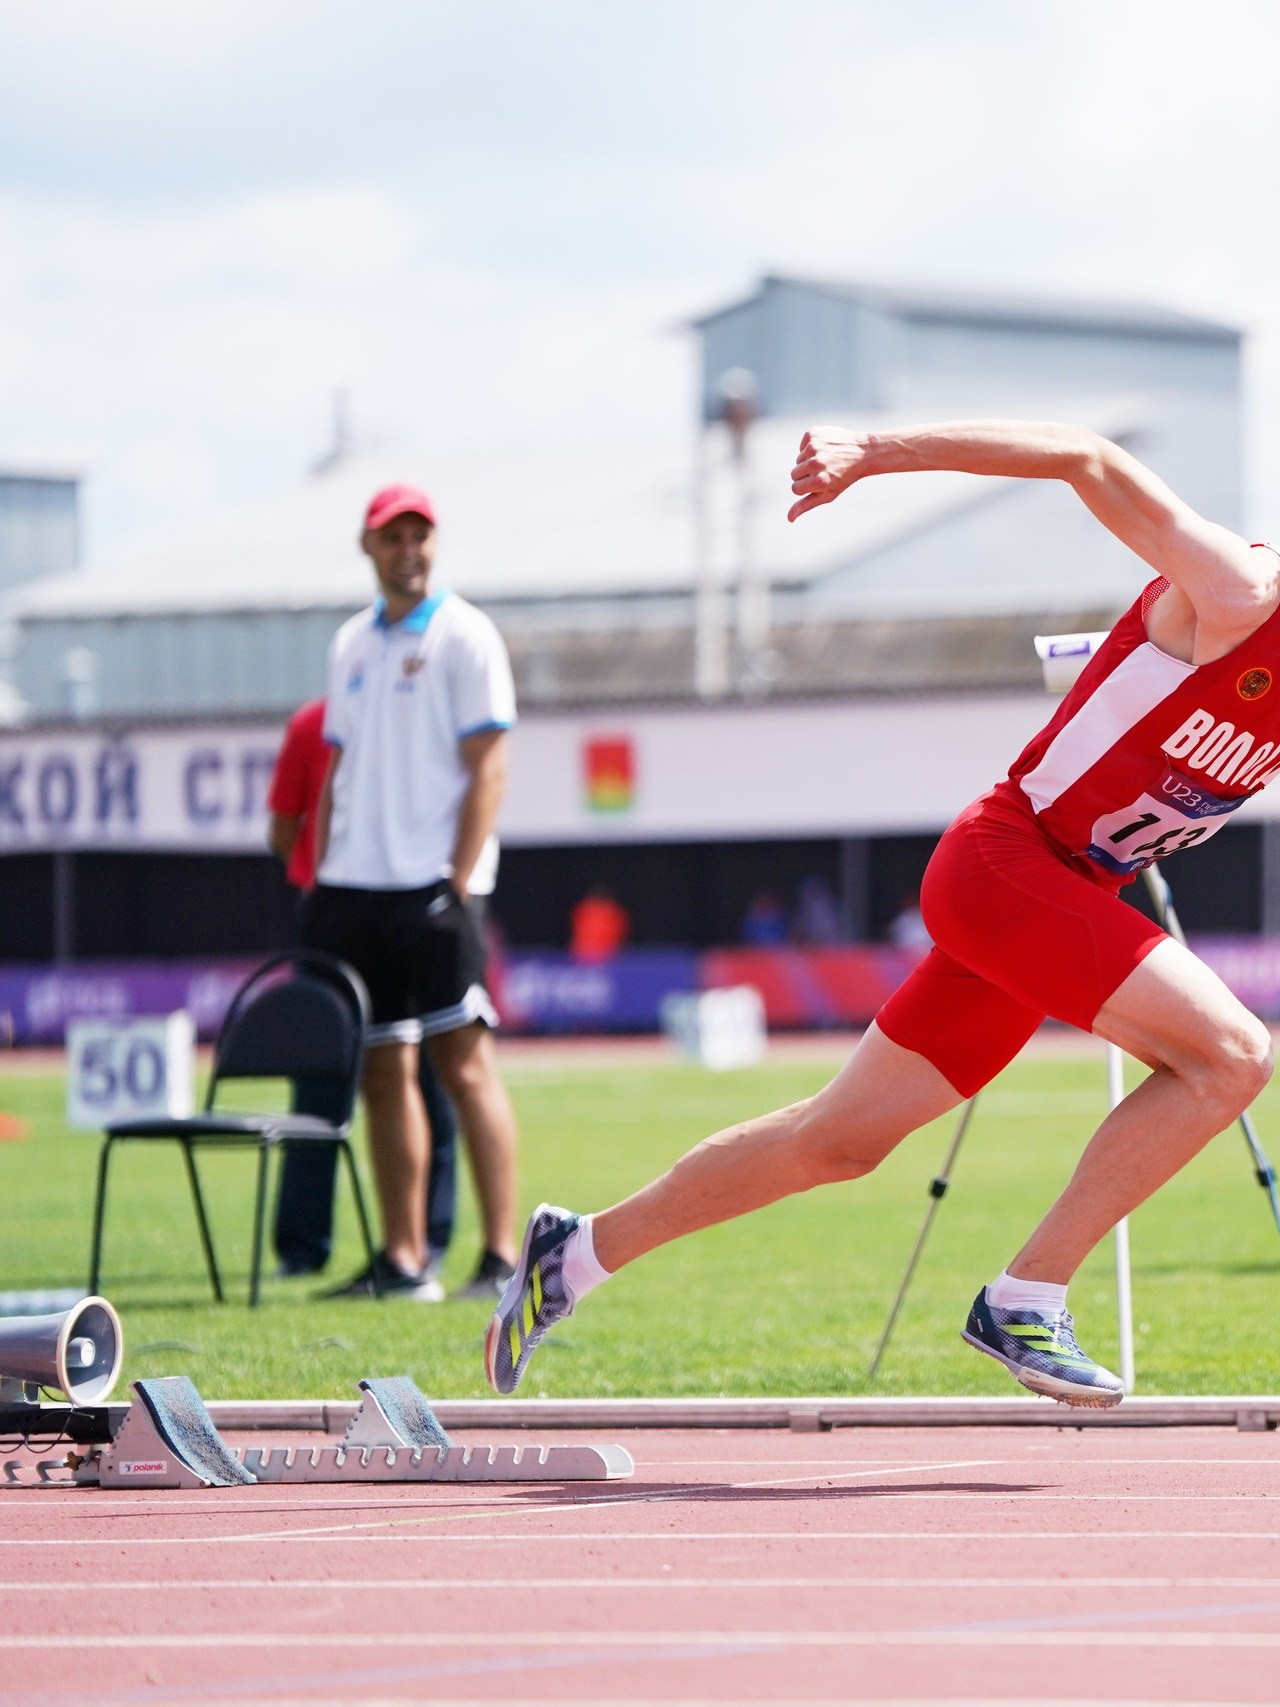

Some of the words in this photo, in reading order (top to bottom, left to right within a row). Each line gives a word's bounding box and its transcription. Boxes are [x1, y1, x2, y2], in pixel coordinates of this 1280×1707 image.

[1162, 775, 1202, 807] U23
[80, 1037, 168, 1107] 50
[133, 1463, 163, 1472] polanik
